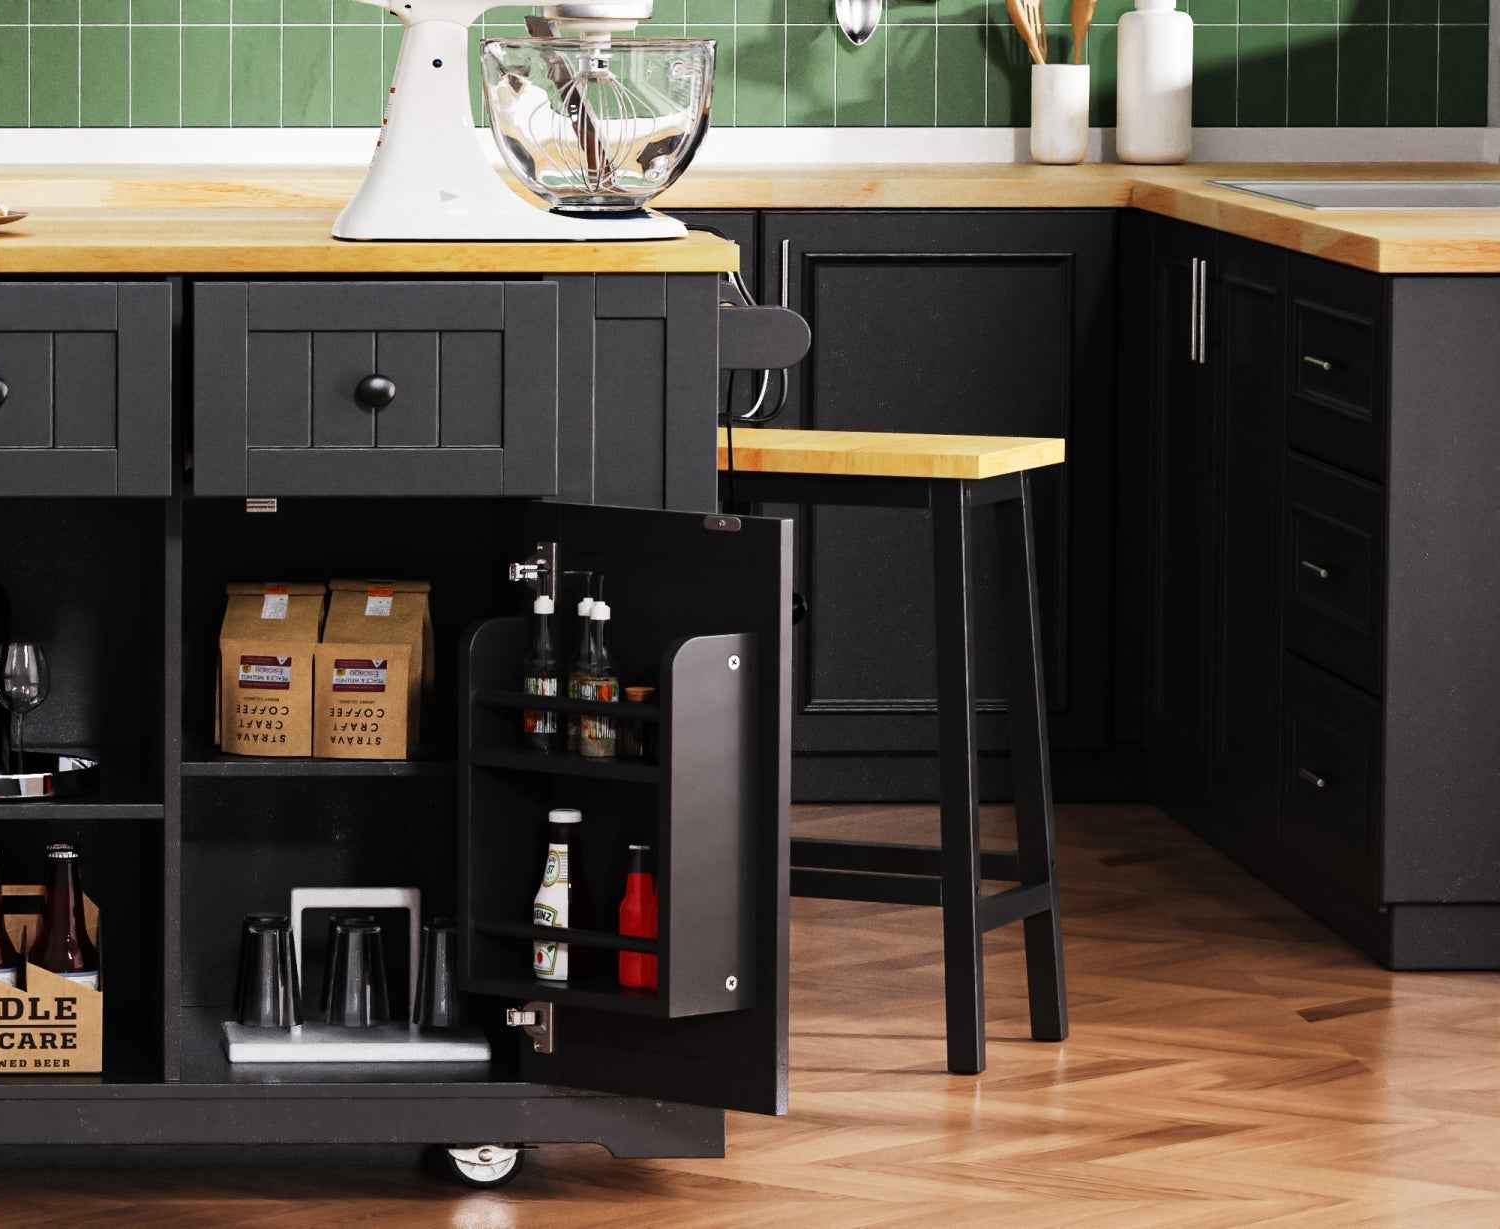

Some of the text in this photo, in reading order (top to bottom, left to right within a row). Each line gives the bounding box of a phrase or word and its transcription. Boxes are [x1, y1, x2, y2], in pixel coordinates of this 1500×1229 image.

[236, 704, 290, 716] COFFEE
[329, 707, 385, 719] COFFEE
[238, 720, 284, 730] CRAFT
[332, 722, 379, 733] CRAFT
[236, 734, 286, 744] STRAVA
[330, 736, 381, 746] STRAVA
[534, 907, 552, 922] EINZ
[34, 1058, 71, 1068] BEER
